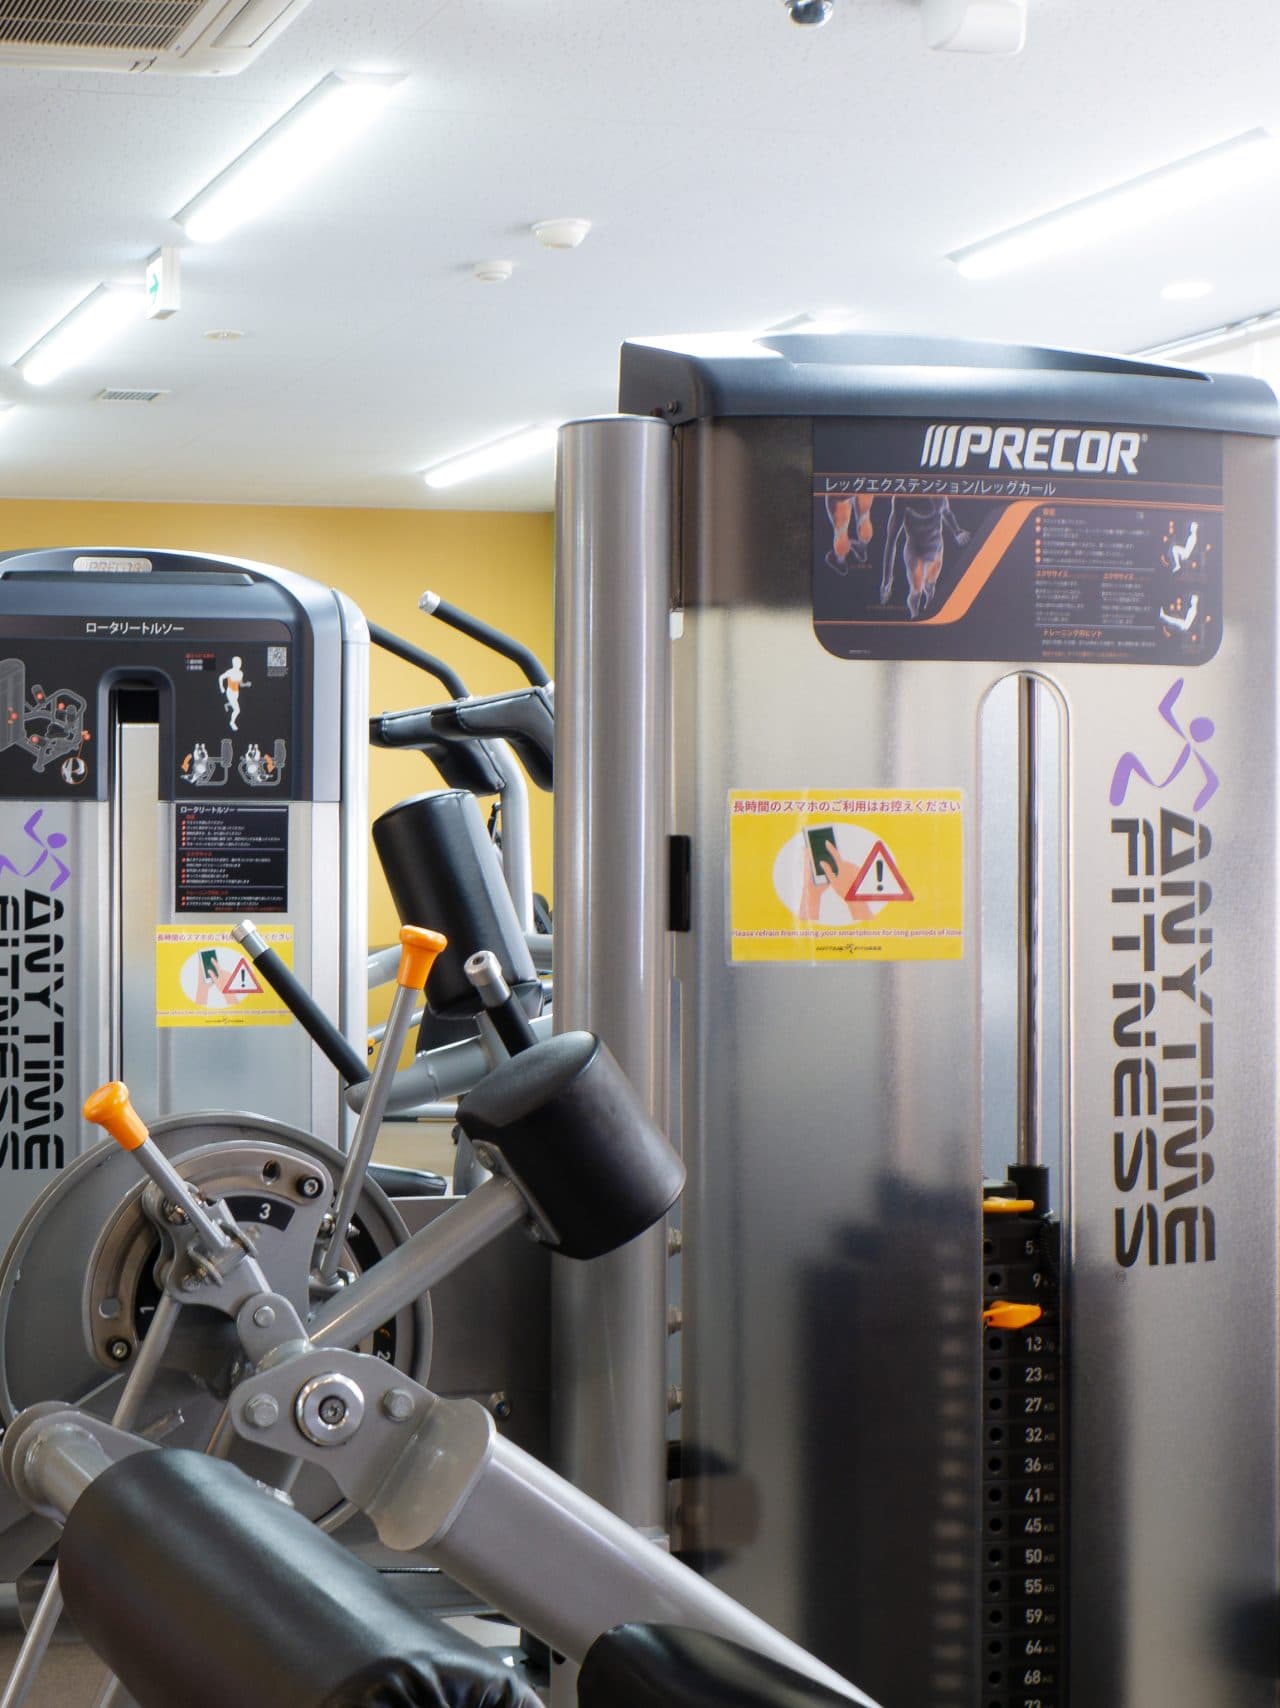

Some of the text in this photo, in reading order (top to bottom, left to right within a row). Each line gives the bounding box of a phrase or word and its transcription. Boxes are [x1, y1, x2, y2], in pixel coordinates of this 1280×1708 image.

[955, 425, 1140, 474] PRECOR
[86, 621, 185, 635] ロータリートルソー
[732, 800, 961, 813] 長時間のスマホのご利用はお控えください
[24, 888, 64, 1170] ANYTIME
[1160, 806, 1217, 1264] ANYTIME
[1111, 818, 1158, 1269] FITNESS
[259, 1203, 271, 1219] 3
[1025, 1240, 1034, 1254] 5
[1032, 1273, 1041, 1287] 9
[1025, 1367, 1042, 1382] 23
[1025, 1398, 1042, 1413] 27
[1025, 1428, 1042, 1443] 32
[1024, 1458, 1042, 1472] 36
[1024, 1488, 1041, 1503] 41
[1024, 1518, 1042, 1533] 45
[1025, 1548, 1042, 1563] 50
[1025, 1579, 1042, 1594] 55
[1025, 1609, 1043, 1624] 59
[1025, 1640, 1042, 1654] 64
[1024, 1670, 1041, 1685] 68
